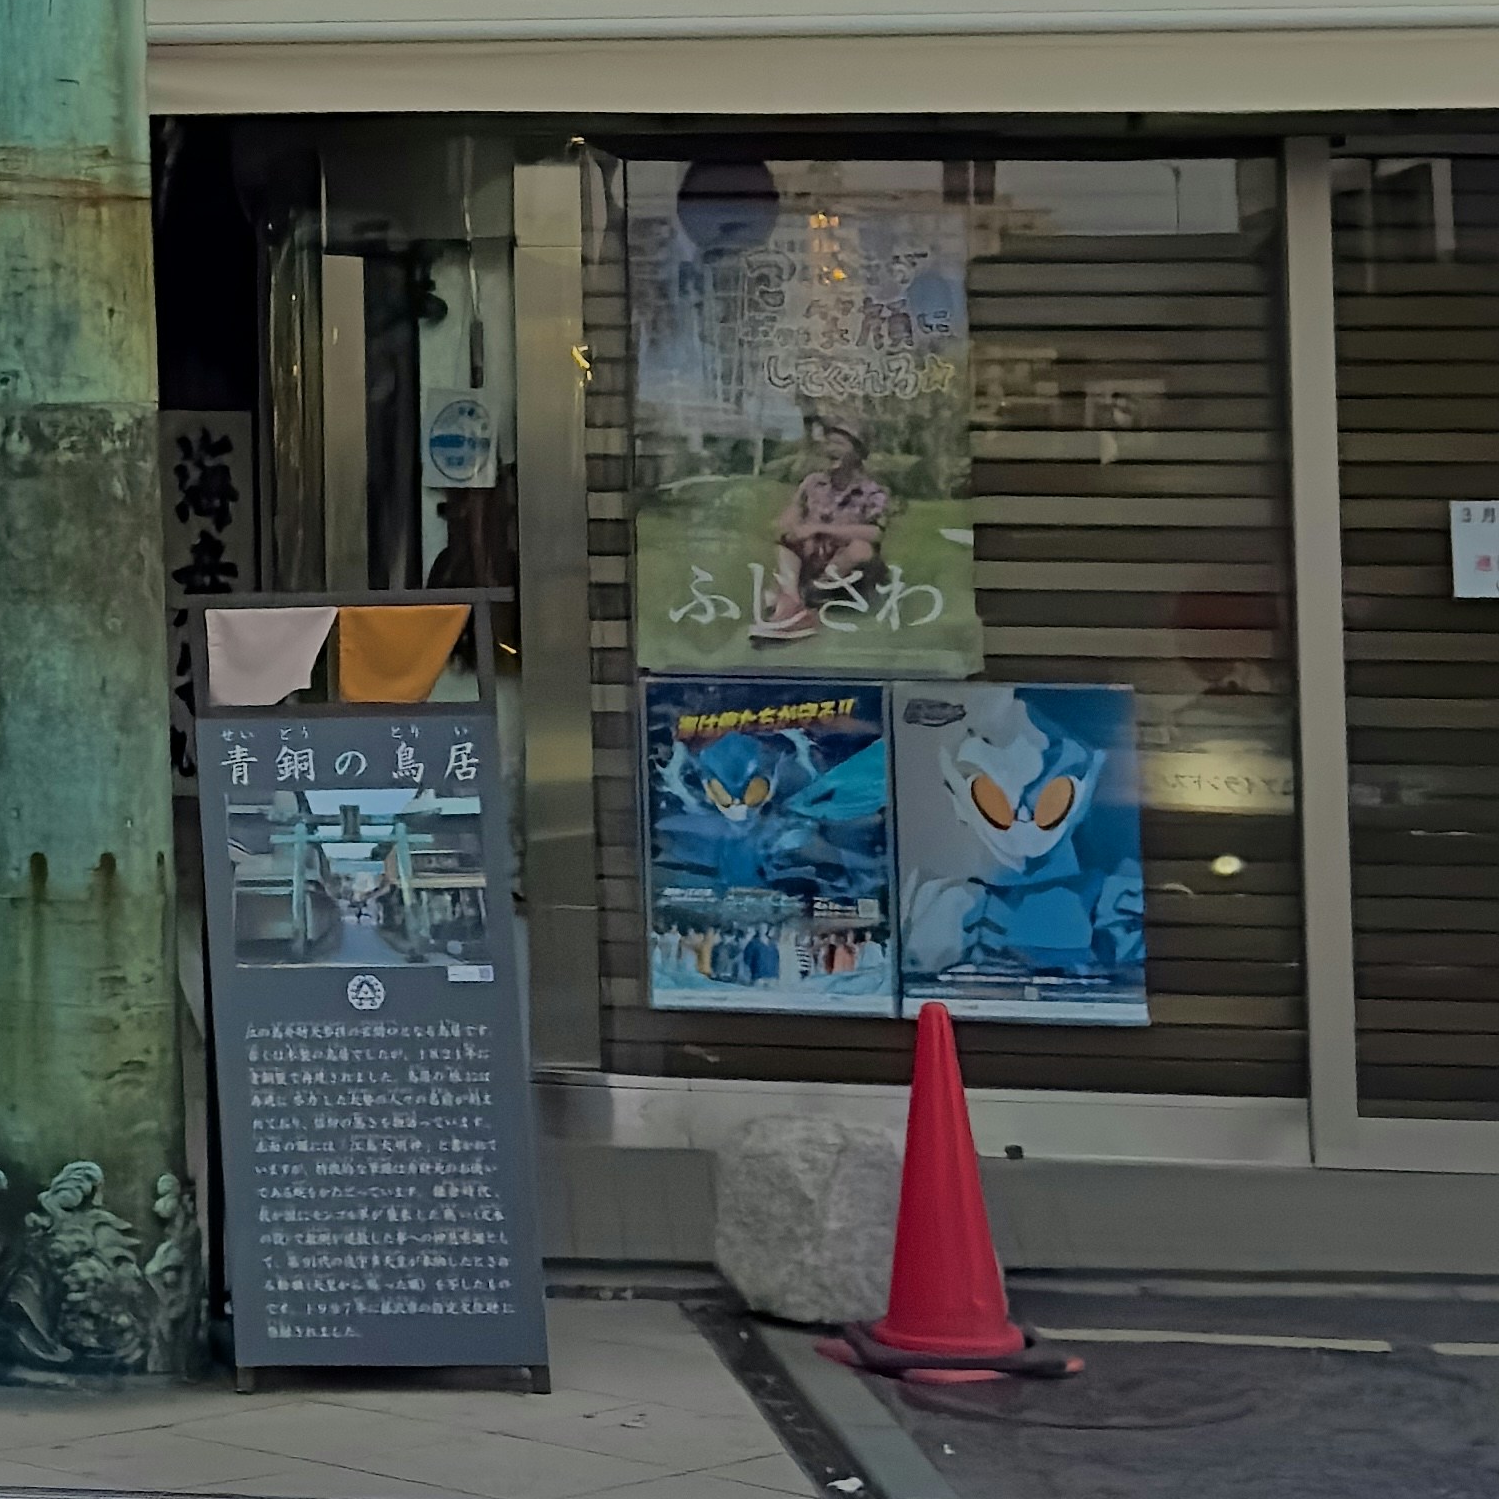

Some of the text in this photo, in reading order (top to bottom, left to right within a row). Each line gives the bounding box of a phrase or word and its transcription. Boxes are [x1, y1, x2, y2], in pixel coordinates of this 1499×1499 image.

[220, 742, 480, 786] 青銅の鳥居
